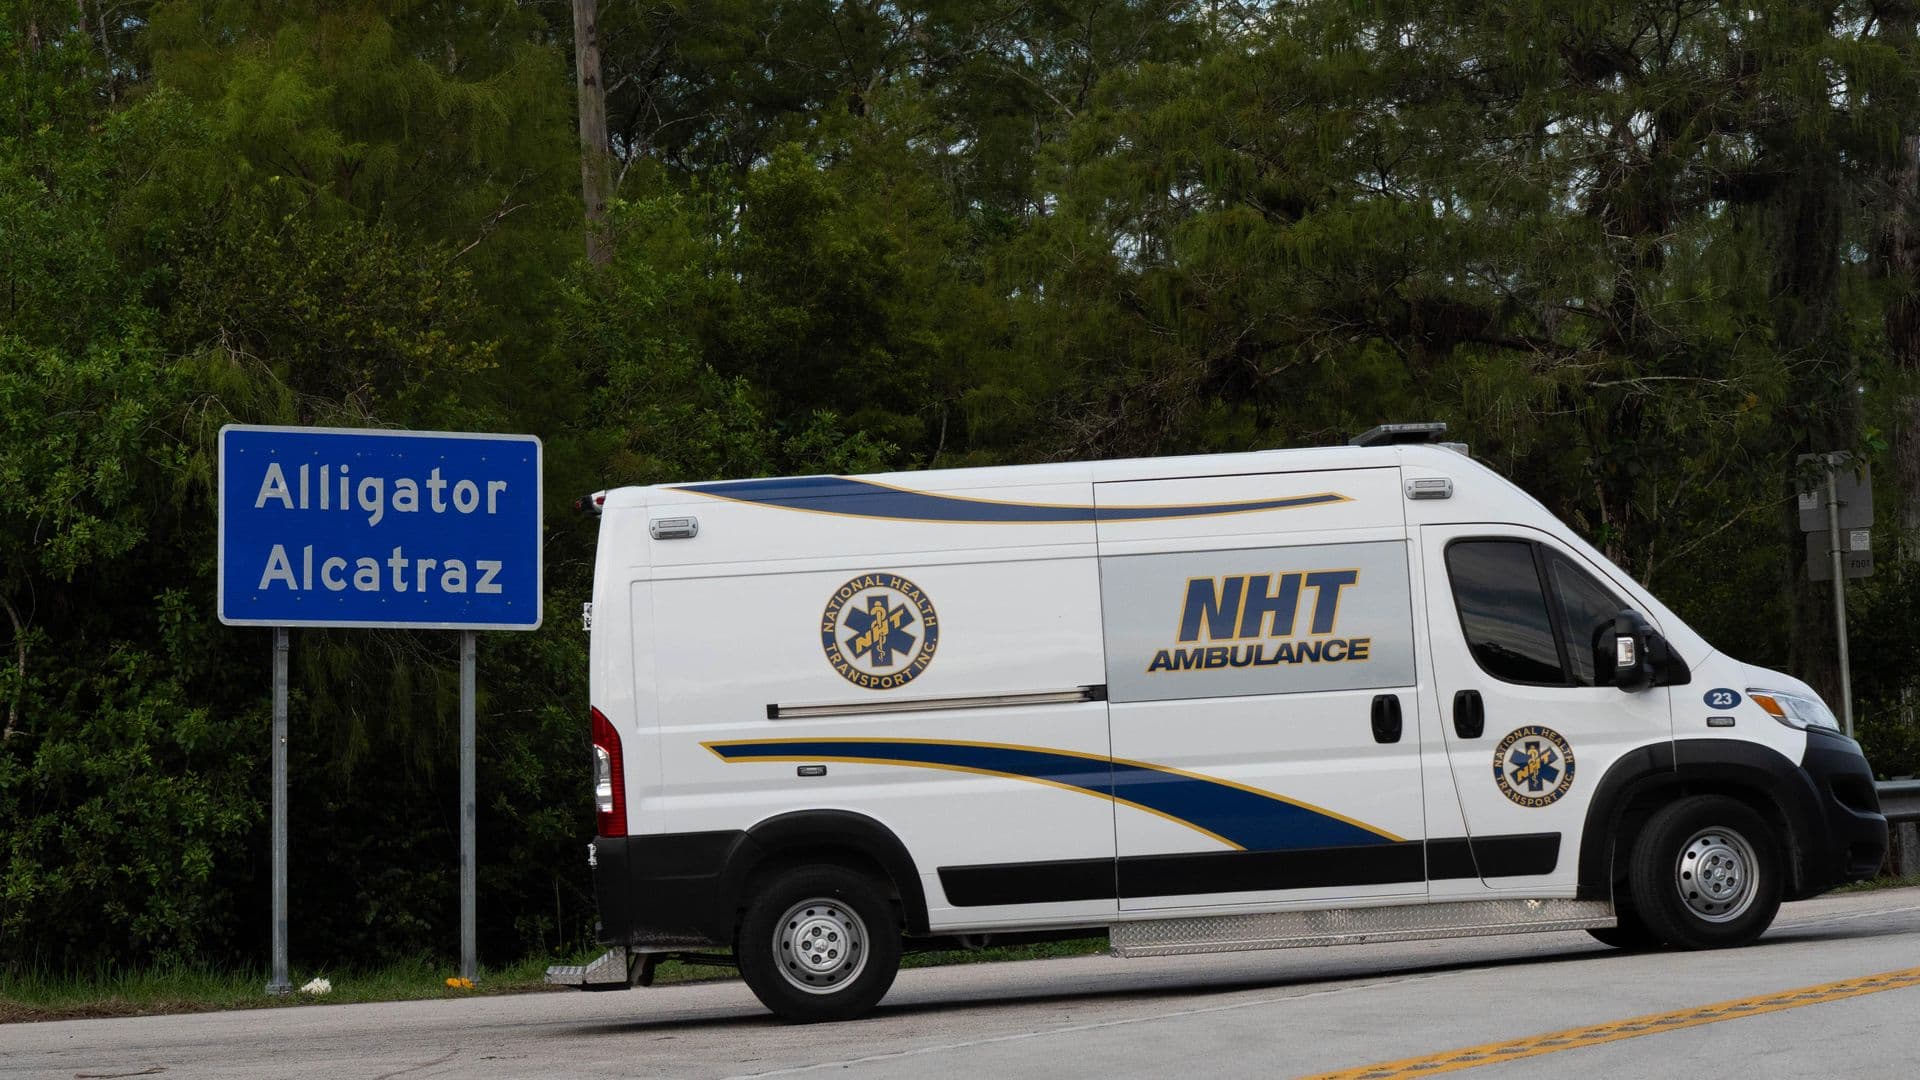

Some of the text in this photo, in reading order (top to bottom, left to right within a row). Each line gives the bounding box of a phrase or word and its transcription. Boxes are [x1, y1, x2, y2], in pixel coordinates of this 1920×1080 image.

[255, 463, 507, 527] Alligator
[258, 544, 502, 594] Alcatraz
[823, 575, 936, 632] NATIONAL HEALTH
[1176, 568, 1361, 644] NHT
[855, 609, 904, 654] NHT
[826, 638, 937, 688] TRANSPORT INC.
[1146, 637, 1371, 673] AMBULANCE
[1712, 692, 1733, 705] 23
[1495, 727, 1574, 767] NATIONAL HEALTH
[1517, 750, 1552, 781] NHT
[1497, 774, 1558, 807] TRANSPORT
